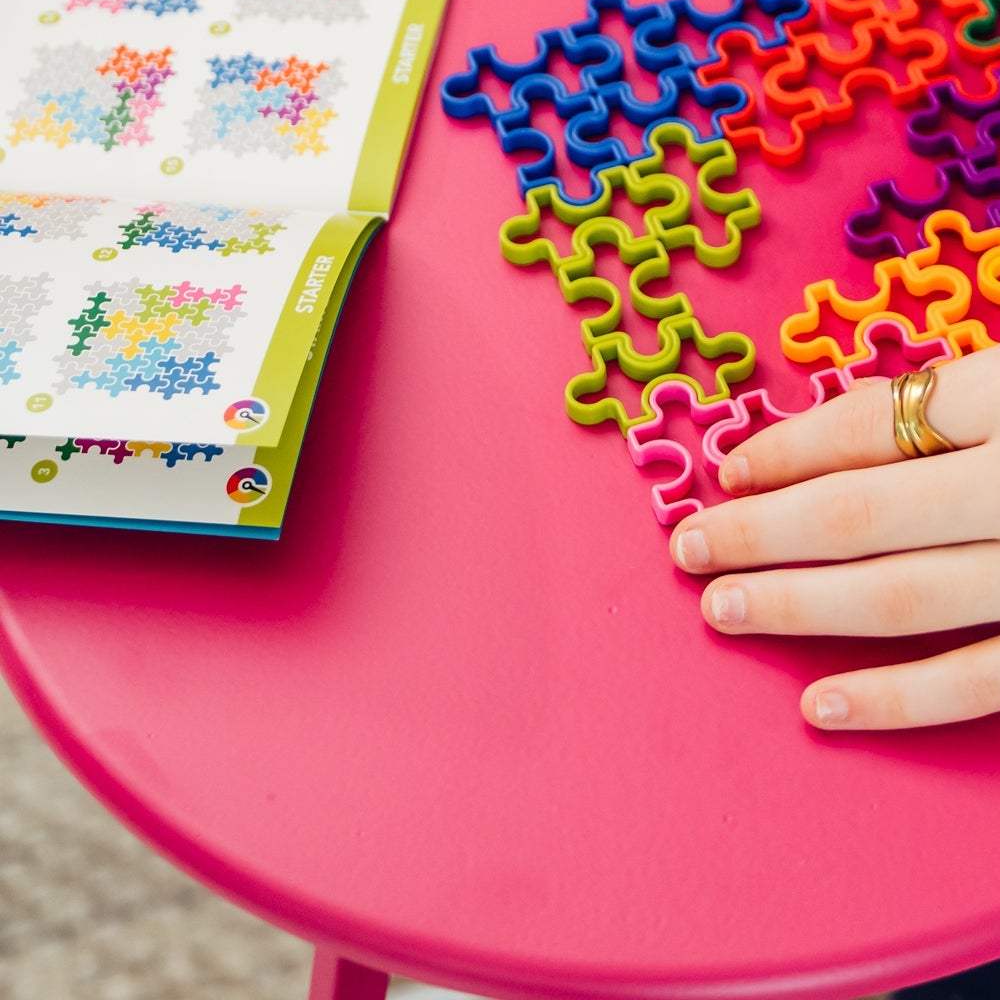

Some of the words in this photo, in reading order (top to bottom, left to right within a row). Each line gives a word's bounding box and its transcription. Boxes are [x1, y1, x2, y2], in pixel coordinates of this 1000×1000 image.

[98, 249, 113, 259] 12
[294, 255, 335, 314] STARTER
[38, 467, 50, 476] 3
